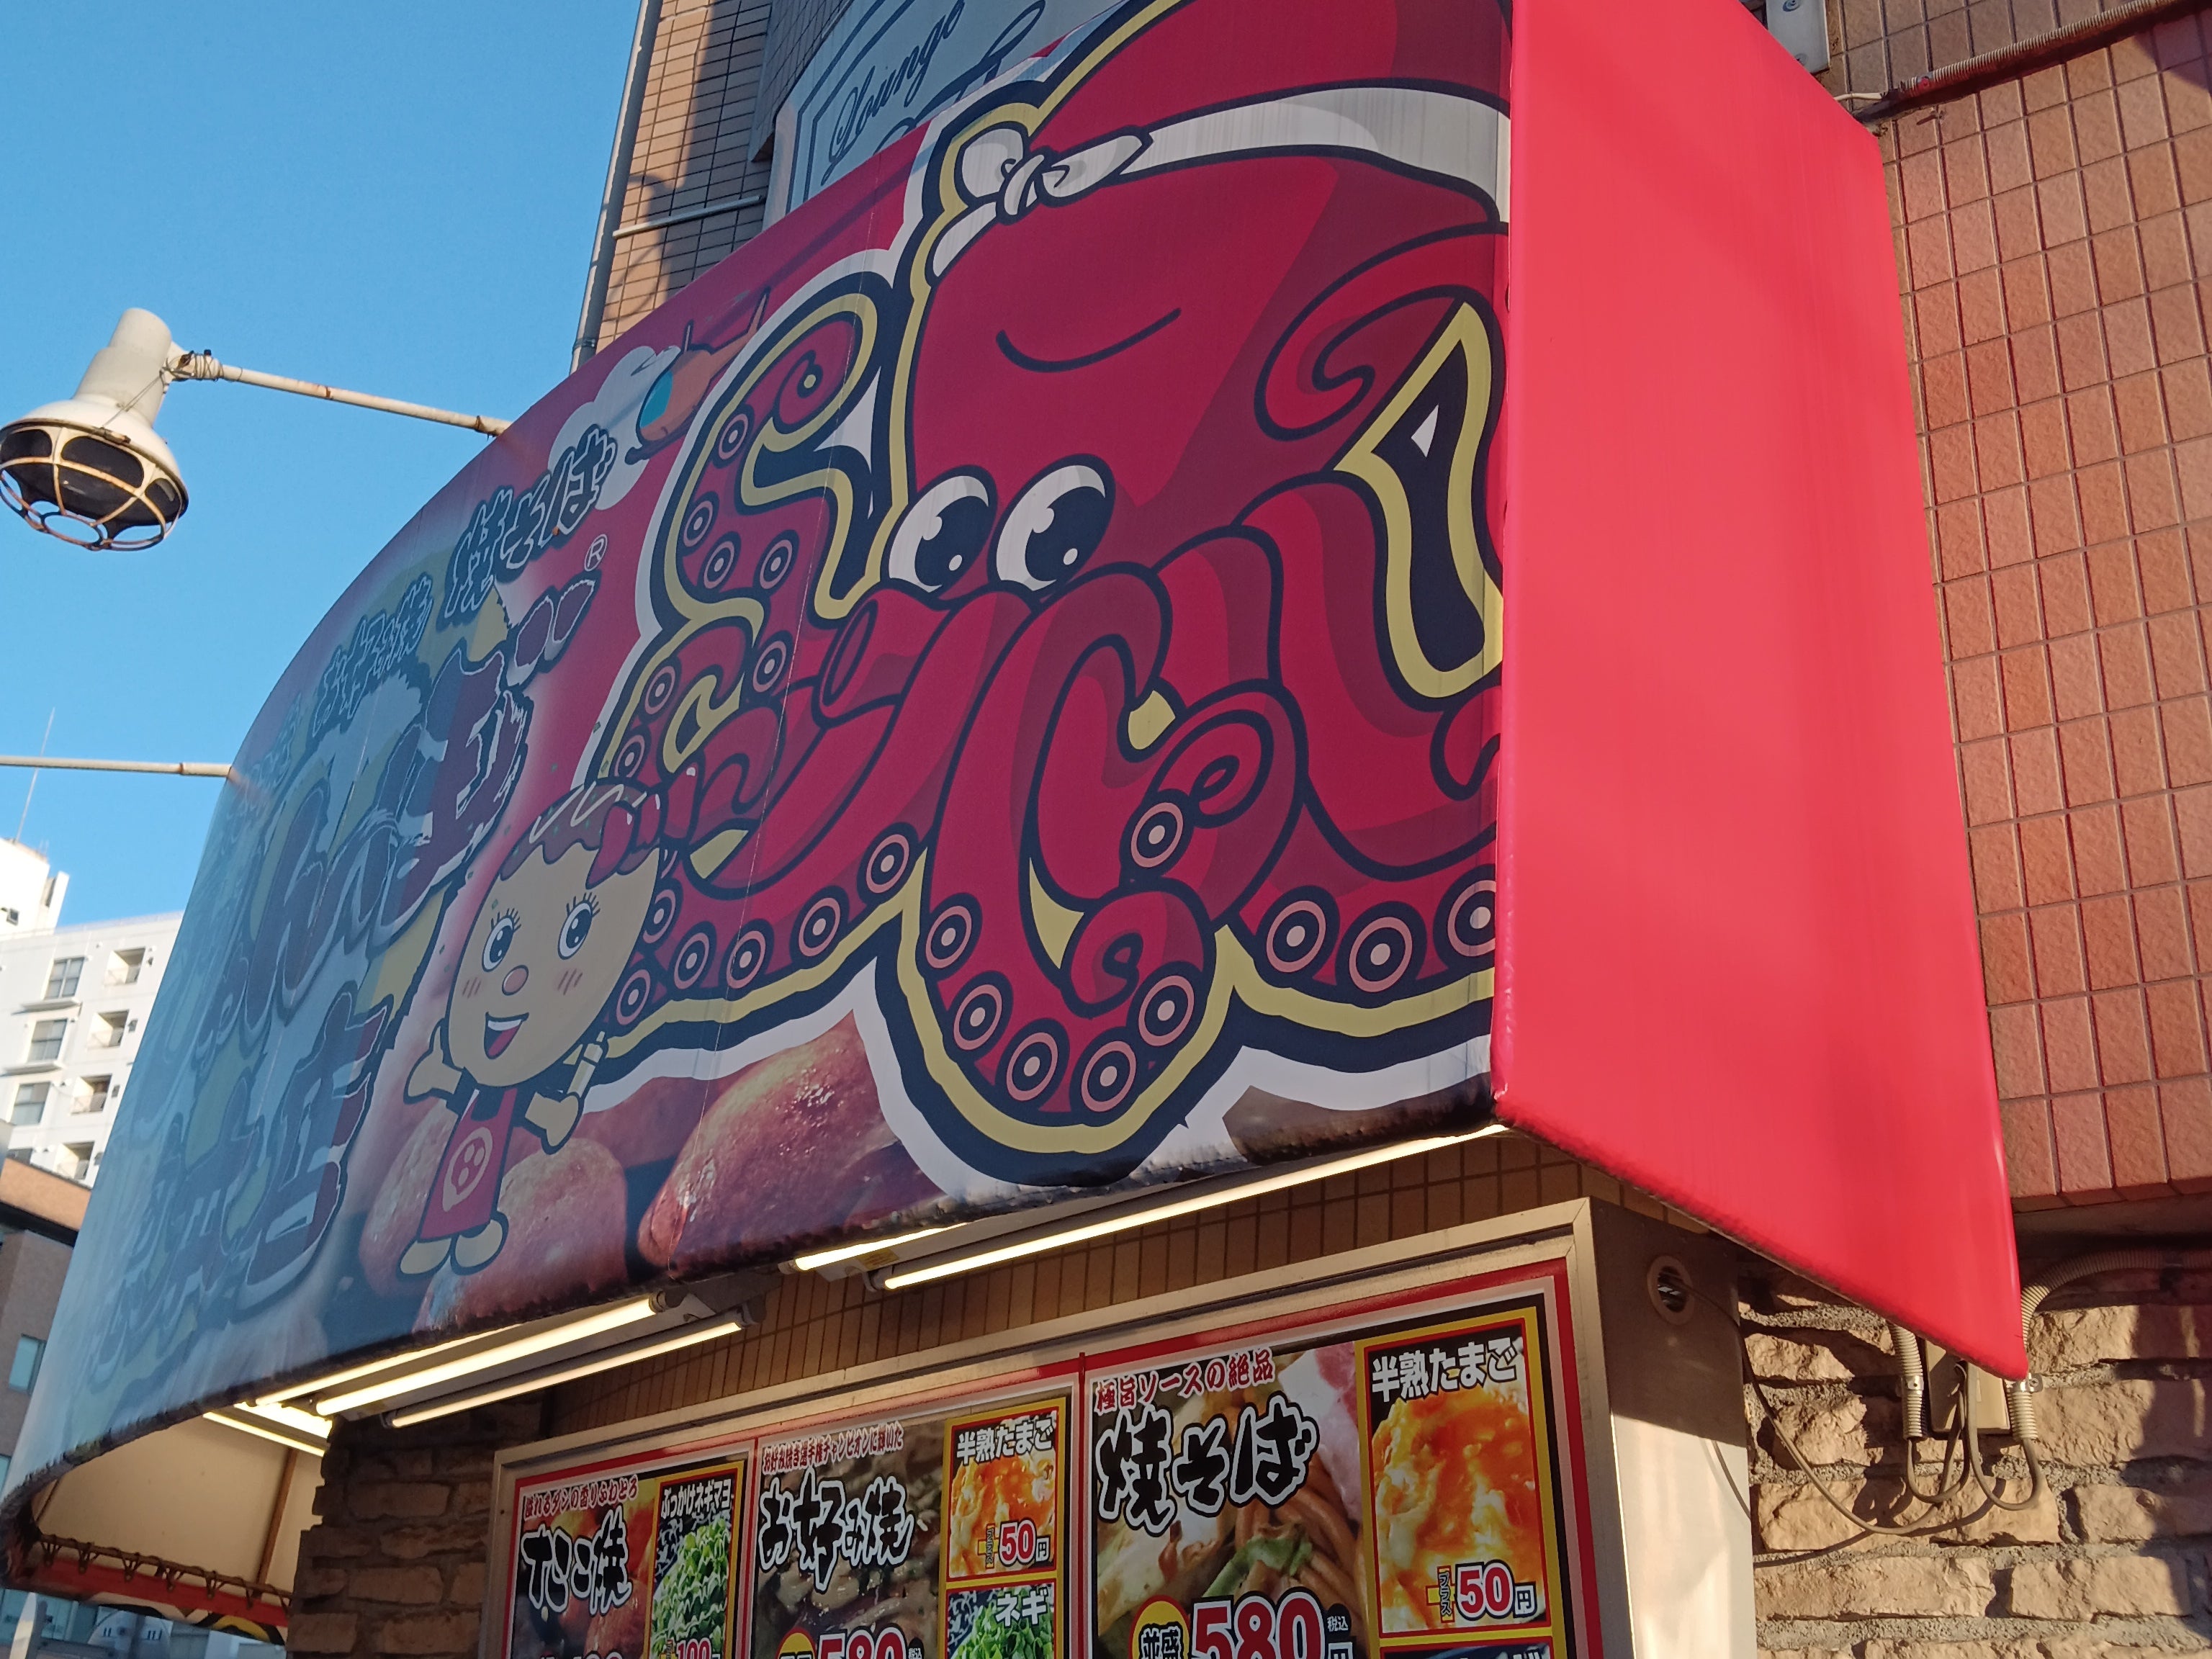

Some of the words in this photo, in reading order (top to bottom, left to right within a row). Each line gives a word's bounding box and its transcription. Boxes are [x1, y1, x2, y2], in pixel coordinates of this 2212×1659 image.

[313, 575, 432, 738] お好み焼
[443, 423, 615, 619] 焼そば
[1094, 1346, 1275, 1416] 極旨ソースの絶品
[1371, 1337, 1521, 1403] 半熟たまご
[956, 1419, 1053, 1465] 半熟たまご
[1095, 1394, 1320, 1537] 焼そば
[660, 1479, 733, 1519] ぶっかけネギマヨ
[758, 1467, 914, 1592] お好み焼
[998, 1519, 1050, 1567] 50円
[994, 1588, 1049, 1627] ネギ
[1439, 1571, 1452, 1617] プラス
[1456, 1560, 1537, 1620] 50円
